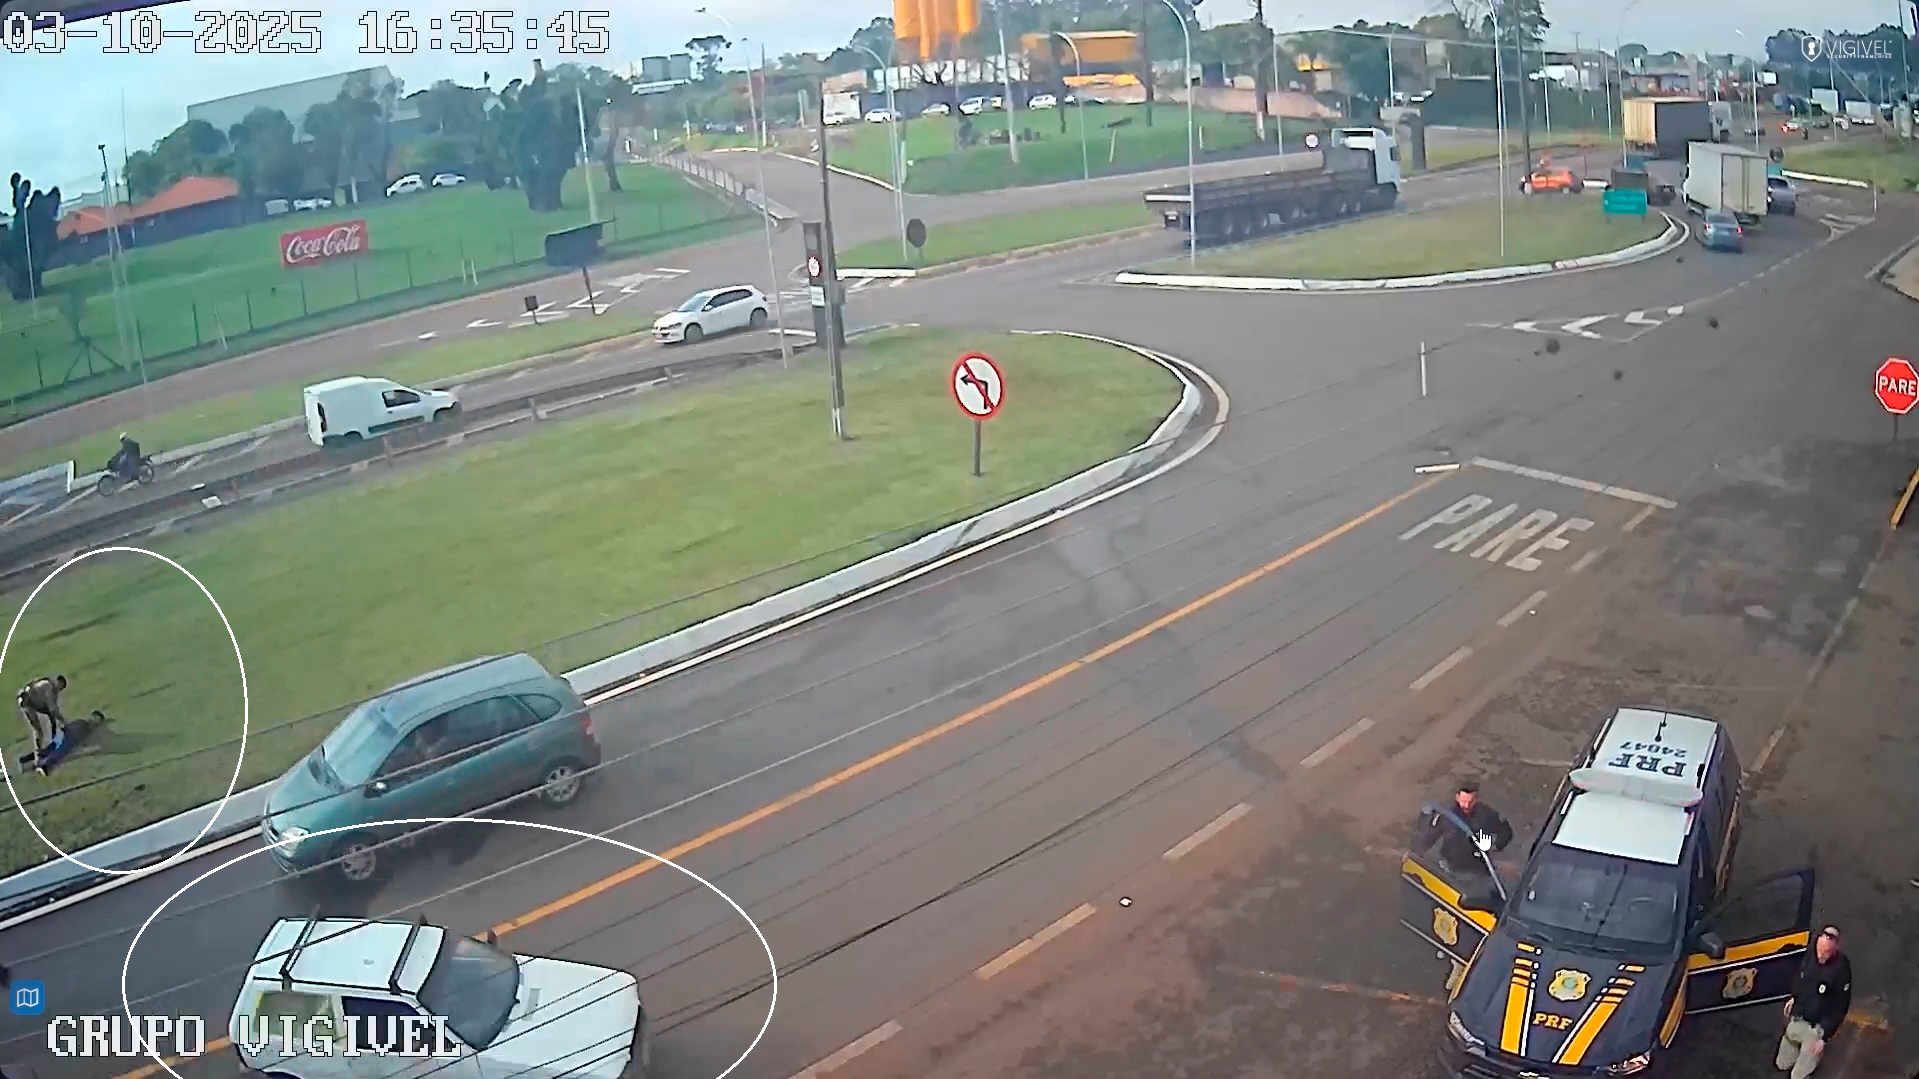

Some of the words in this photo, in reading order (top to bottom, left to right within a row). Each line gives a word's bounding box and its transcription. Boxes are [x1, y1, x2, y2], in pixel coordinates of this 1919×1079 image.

[1879, 376, 1917, 396] PARE
[1398, 493, 1595, 571] PARE
[1608, 753, 1687, 777] PRF
[1532, 1012, 1573, 1031] PRF
